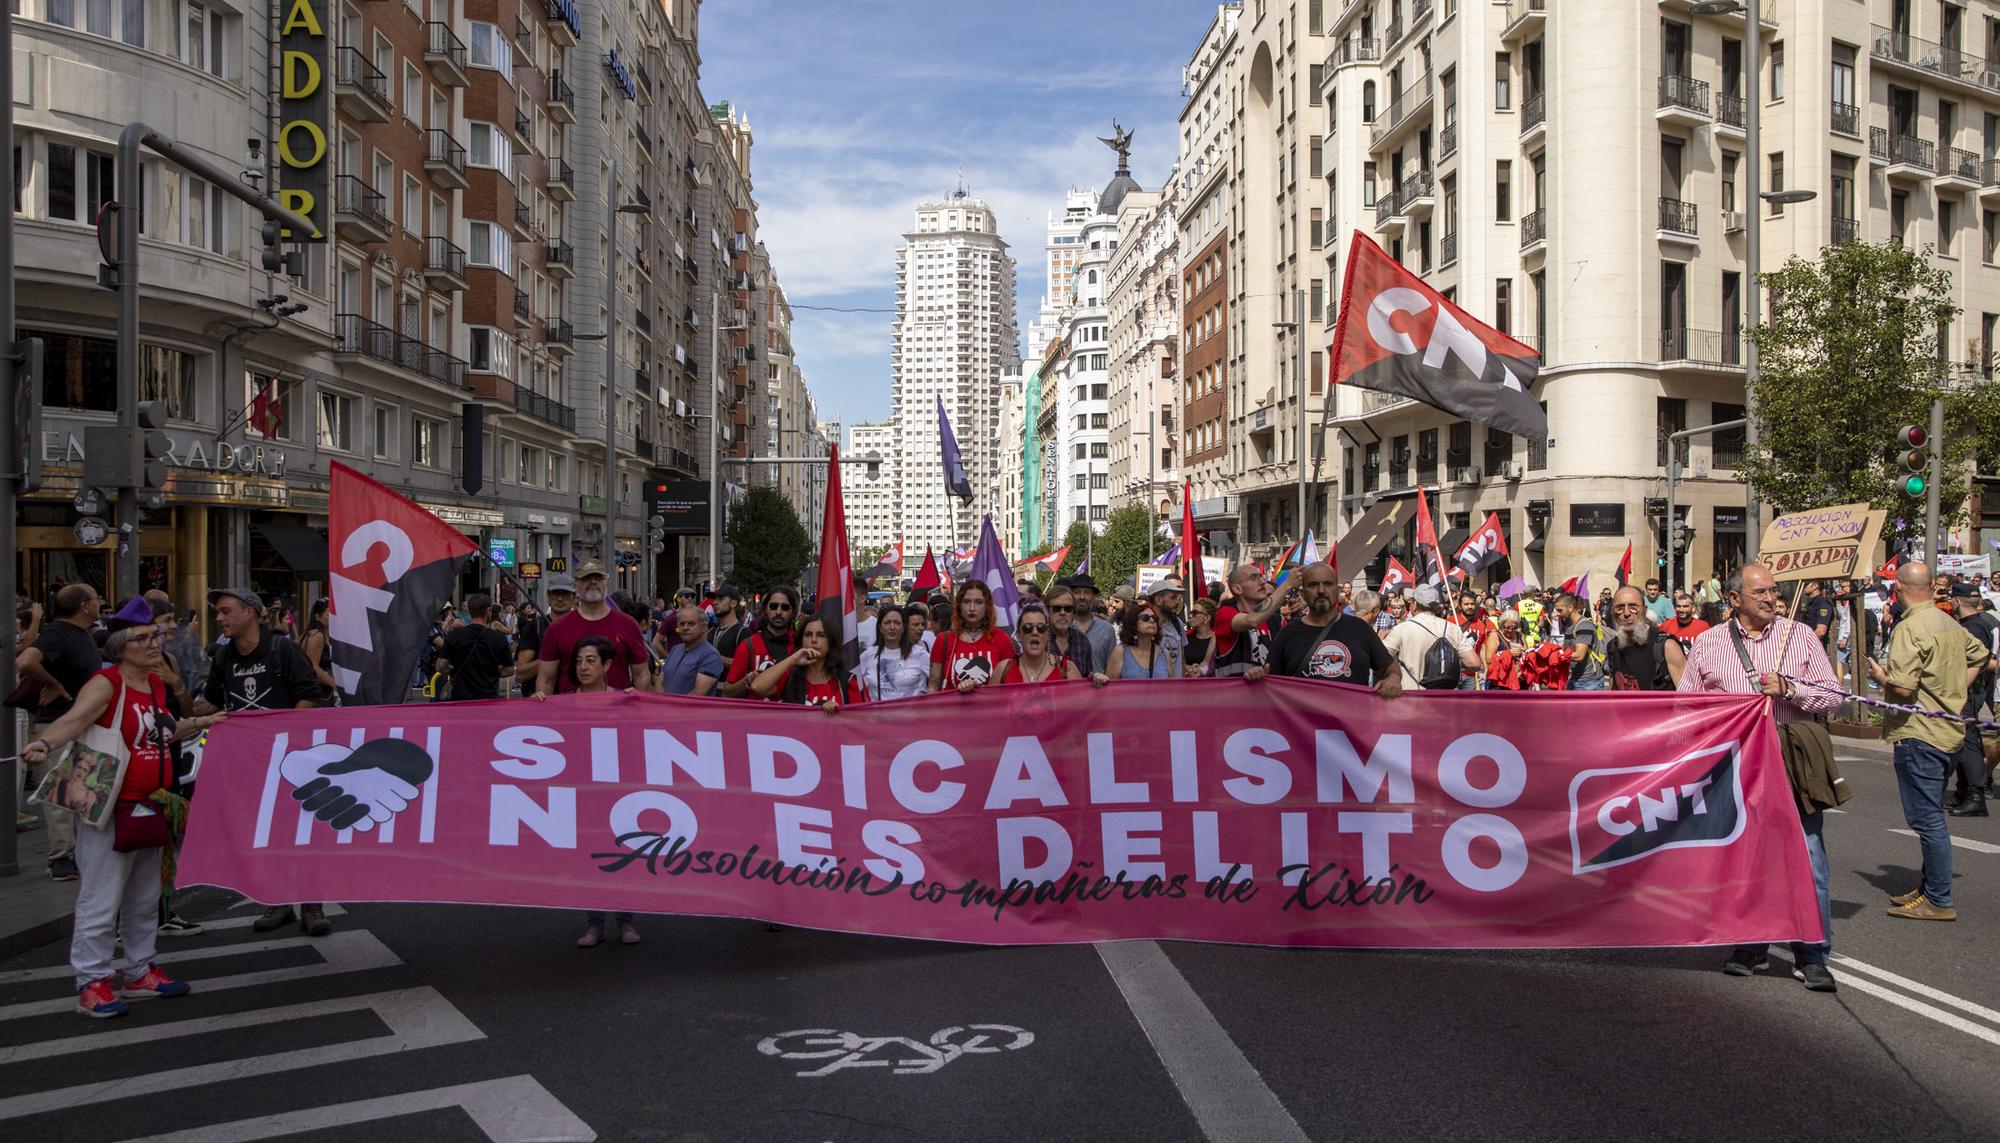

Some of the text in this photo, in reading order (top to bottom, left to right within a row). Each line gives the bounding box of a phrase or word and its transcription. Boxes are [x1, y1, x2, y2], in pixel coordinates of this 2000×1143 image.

[1046, 441, 1056, 498] SENATOR
[1780, 527, 1813, 540] CNT
[489, 725, 1528, 814] SINDICALISMO
[1597, 774, 1713, 836] CNT
[488, 784, 1530, 892] NO ES DELITO
[591, 830, 1434, 922] Absolución compañeras de Xixón
